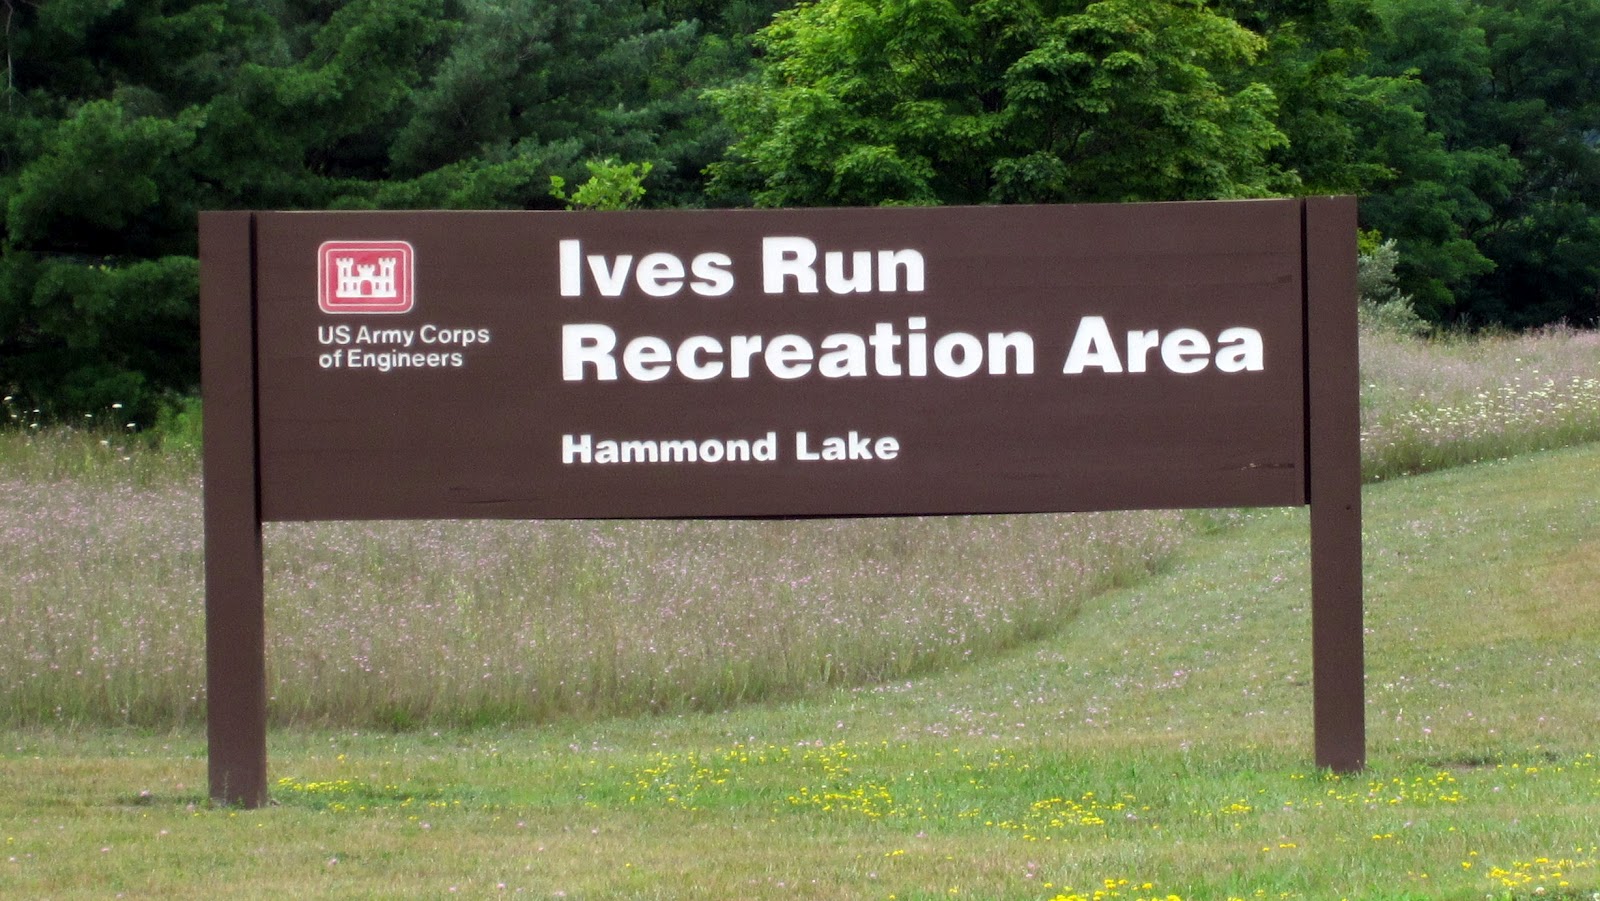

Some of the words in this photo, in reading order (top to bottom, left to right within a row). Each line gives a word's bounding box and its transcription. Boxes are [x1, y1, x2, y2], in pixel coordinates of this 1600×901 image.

[558, 239, 735, 298] Ives
[762, 236, 925, 295] Run
[317, 325, 351, 345] US
[355, 325, 415, 347] Army
[419, 324, 491, 347] Corps
[561, 316, 1035, 382] Recreation
[1062, 315, 1265, 375] Area
[318, 349, 342, 369] of
[347, 349, 464, 372] Engineers
[561, 432, 777, 465] Hammond
[795, 431, 900, 462] Lake
